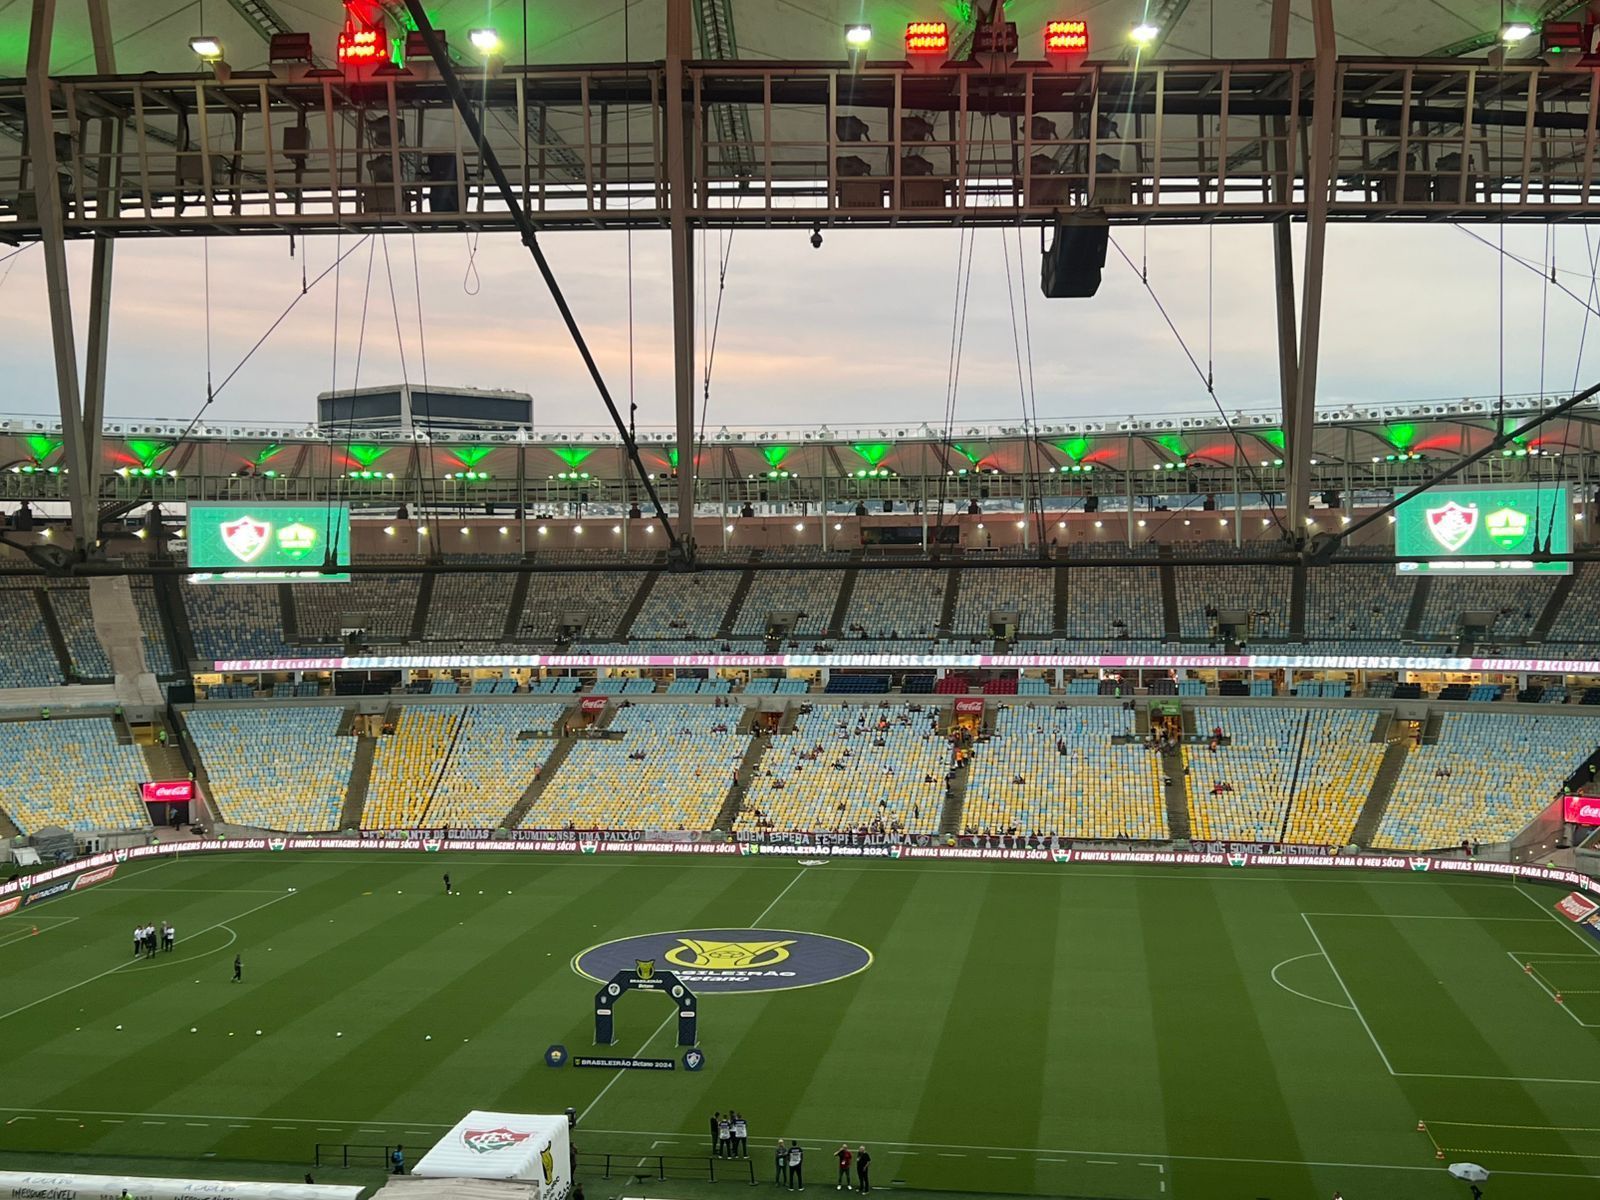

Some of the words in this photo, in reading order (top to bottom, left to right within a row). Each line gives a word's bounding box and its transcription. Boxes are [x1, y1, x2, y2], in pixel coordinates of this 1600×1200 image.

[548, 656, 590, 666] OFERTAS
[593, 656, 650, 666] EXCLUSIVAS
[991, 656, 1035, 666] OFERTAS
[1038, 656, 1100, 666] EXCLUSIVAS
[1482, 660, 1532, 671] OFERTAS
[201, 841, 220, 850] PARA
[245, 839, 264, 848] SÓCIO
[360, 840, 377, 848] PARA
[385, 840, 399, 849] MEU
[400, 838, 419, 849] SÓCIO
[516, 842, 533, 850] PARA
[541, 842, 555, 851] MEU
[557, 840, 576, 851] SÓCIO
[675, 844, 692, 852] PARA
[701, 844, 714, 852] MEU
[716, 843, 735, 853] SÓCIO
[760, 845, 830, 855] BRASILEIRÃO
[831, 846, 861, 855] Betano
[863, 847, 889, 856] 2024
[982, 850, 1001, 858] PARA
[1010, 850, 1025, 859] MEU
[1026, 849, 1047, 859] SÓCIO
[1155, 853, 1175, 862] PARA
[1201, 853, 1223, 863] SÓCIO
[1335, 858, 1355, 866] PARA
[1364, 858, 1380, 867] MEU
[1382, 857, 1405, 868] SÓCIO
[1521, 866, 1541, 877] PARA
